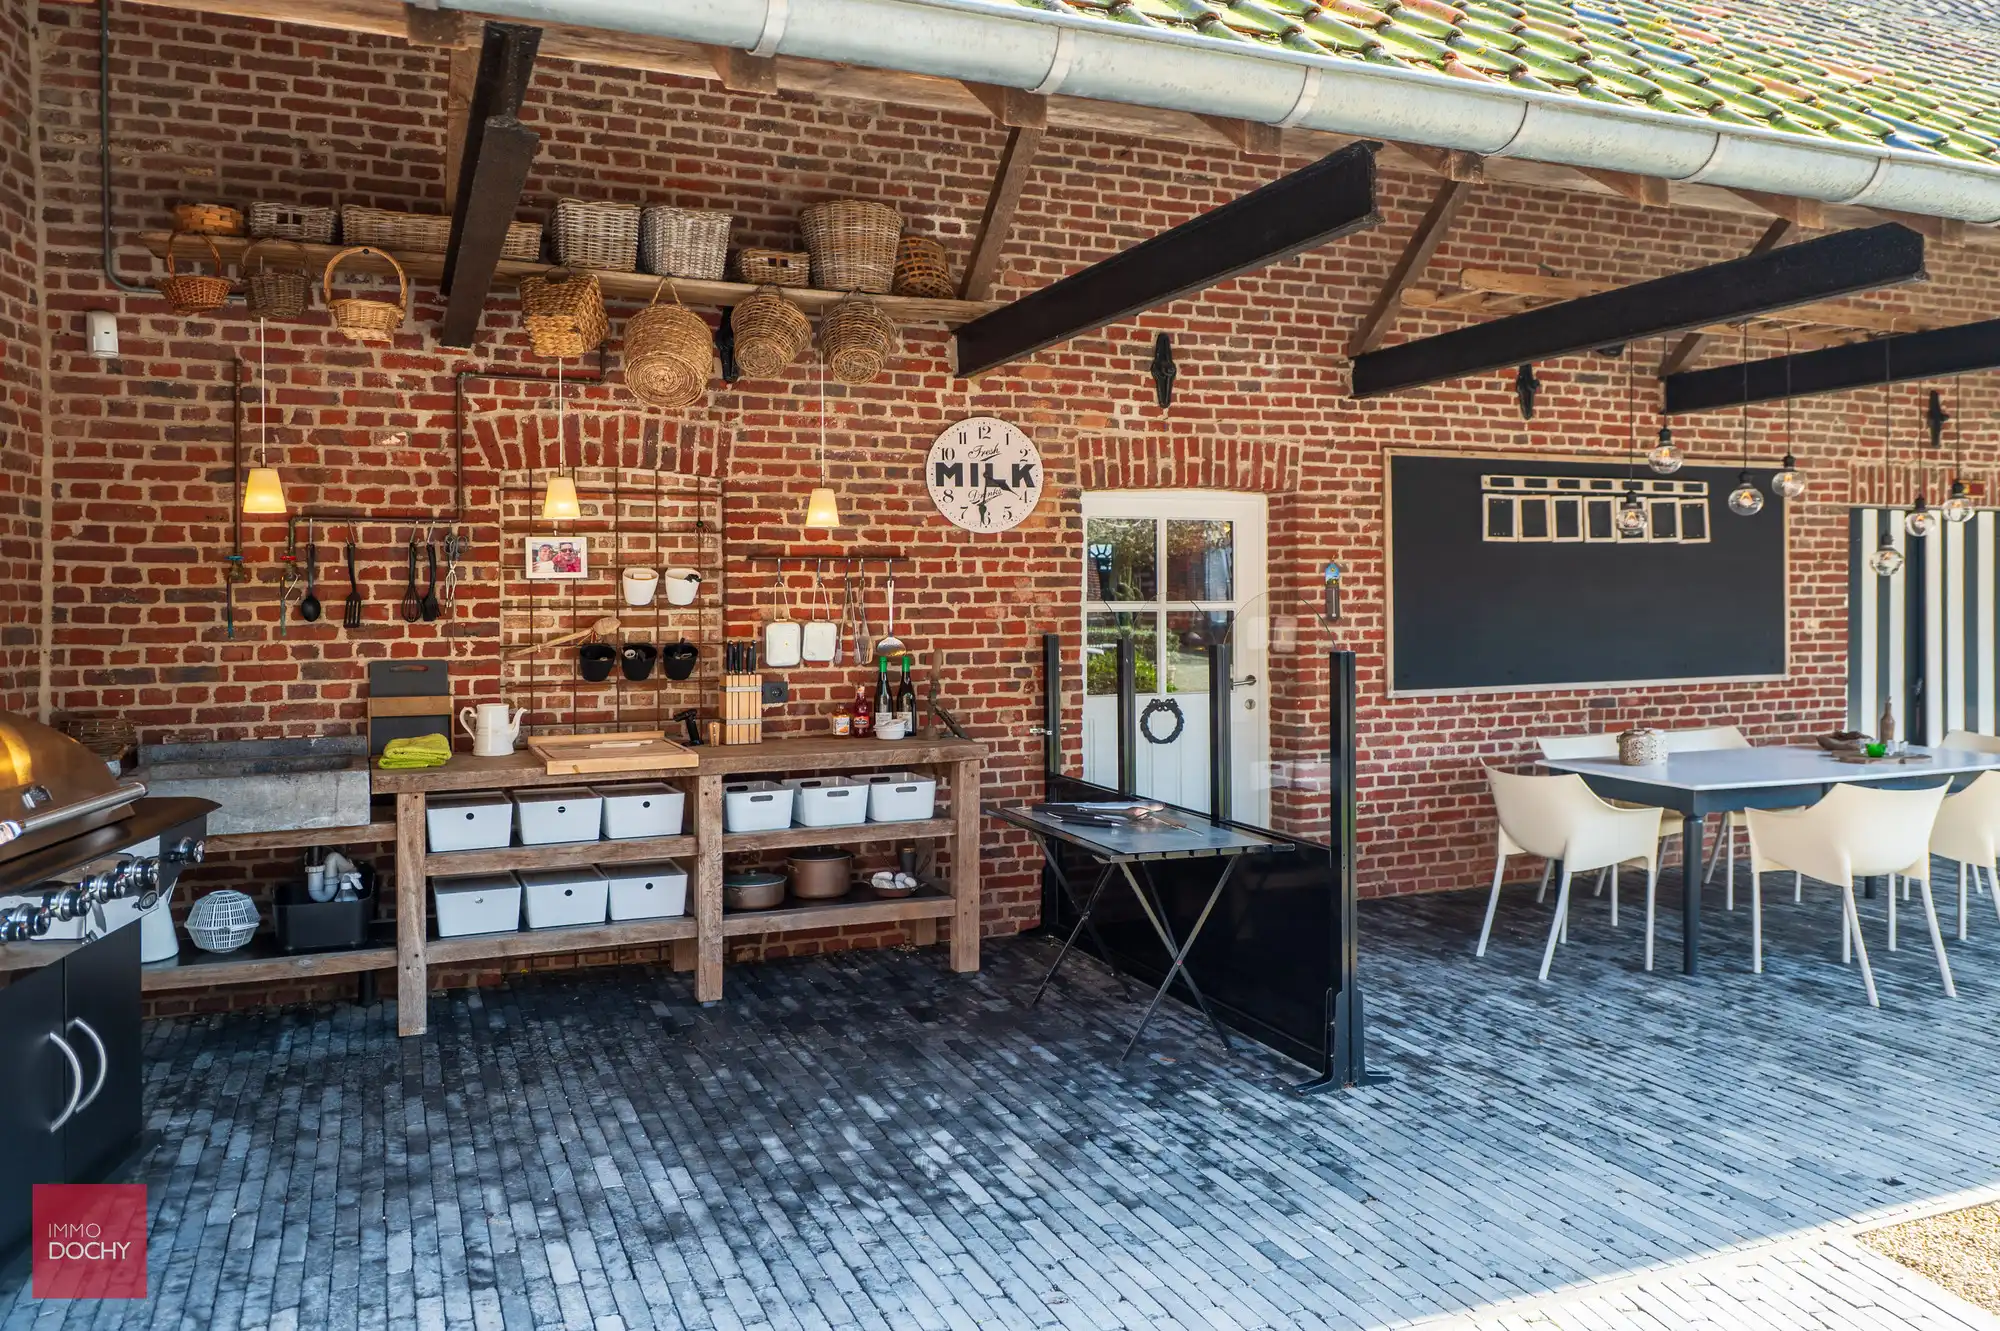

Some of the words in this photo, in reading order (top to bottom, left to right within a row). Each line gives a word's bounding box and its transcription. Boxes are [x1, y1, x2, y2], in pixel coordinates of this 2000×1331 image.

[958, 432, 967, 444] 11
[978, 426, 991, 439] 12
[1005, 432, 1009, 445] 1
[941, 447, 955, 461] 10
[968, 442, 1001, 461] Fresh
[1019, 449, 1028, 462] 2
[935, 462, 1036, 487] MILK
[942, 489, 954, 503] 8
[968, 487, 1003, 504] Drnks
[1019, 490, 1028, 503] 4
[960, 506, 968, 520] 7
[1003, 506, 1012, 520] 5
